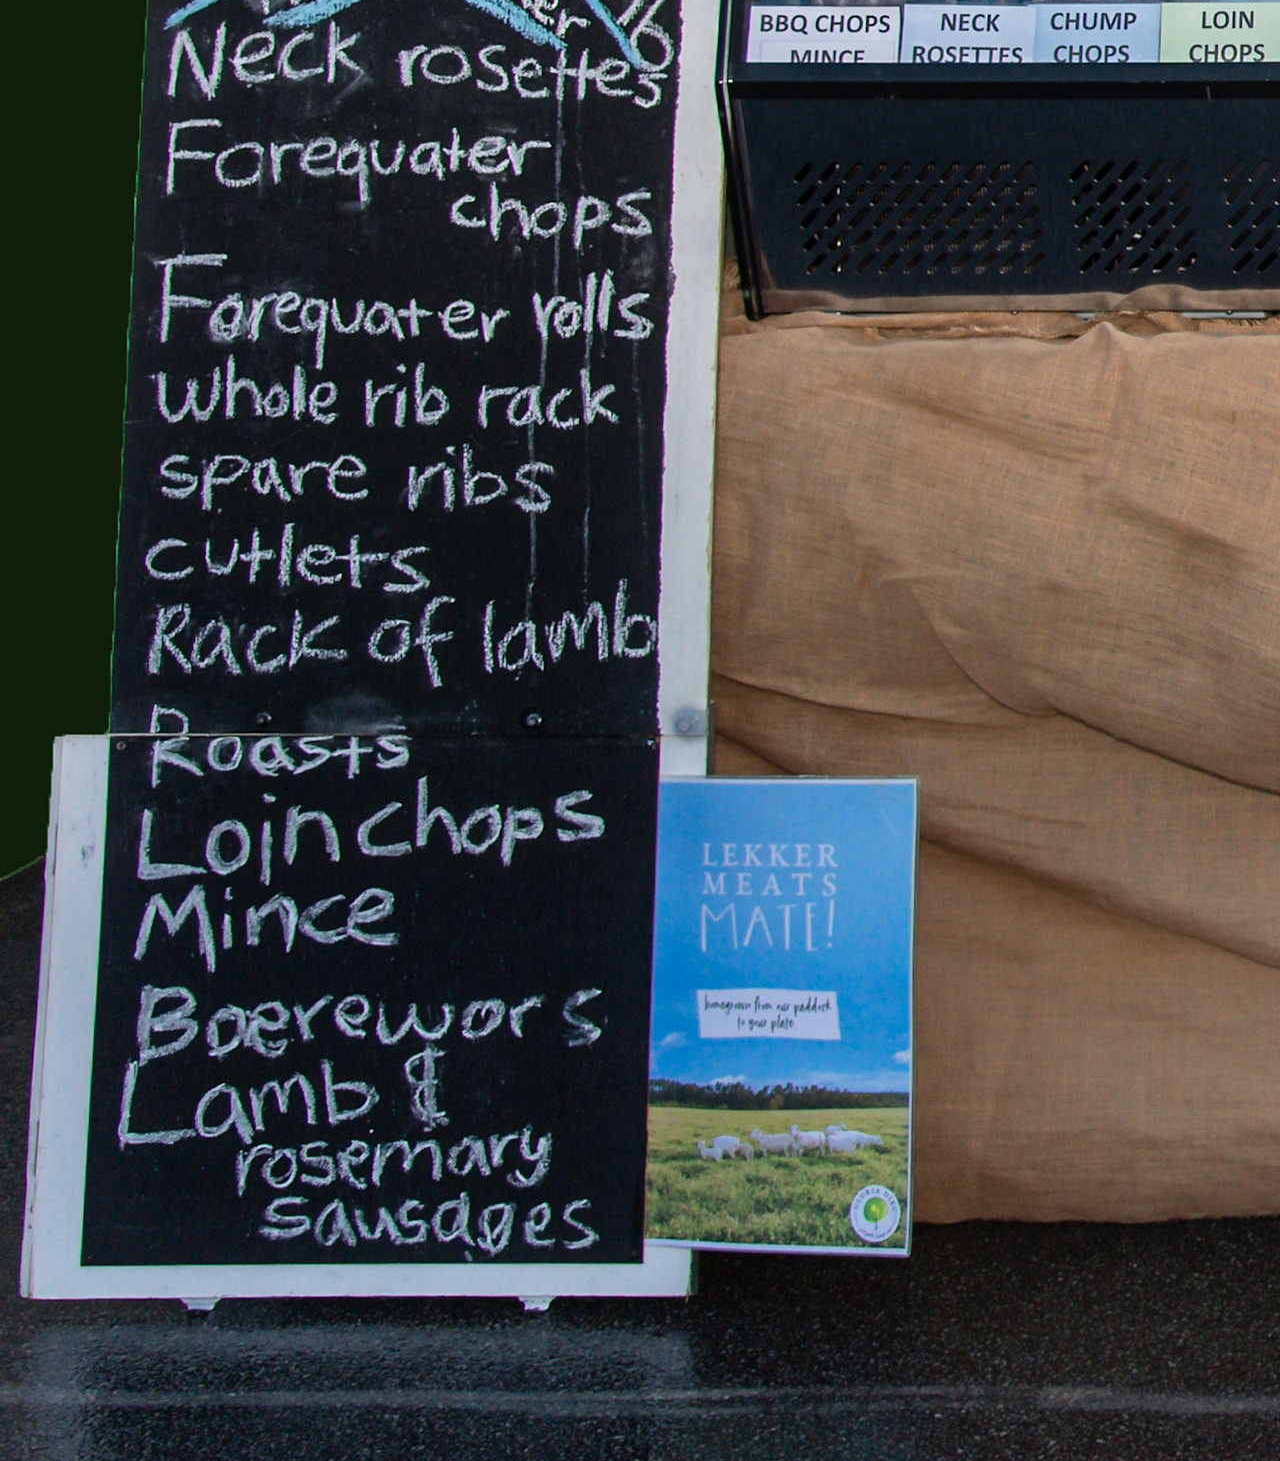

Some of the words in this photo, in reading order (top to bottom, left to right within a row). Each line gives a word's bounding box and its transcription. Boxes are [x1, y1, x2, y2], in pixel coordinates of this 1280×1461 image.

[760, 15, 808, 34] BBQ
[815, 15, 891, 33] CHOPS
[940, 13, 1000, 32] NECK
[1050, 12, 1137, 30] CHUMP
[1189, 44, 1266, 62] CHOPS
[1201, 11, 1255, 29] LOIN
[165, 20, 364, 100] Neck
[398, 44, 670, 108] rosettes
[790, 49, 865, 63] MINCE
[913, 46, 1023, 63] ROSETTES
[1053, 45, 1131, 63] CHOPS
[165, 120, 551, 209] Forequater
[450, 182, 653, 249] chops
[155, 253, 509, 369] Forequater
[533, 270, 654, 340] rolls
[365, 362, 449, 427] rib
[478, 368, 620, 429] rack
[159, 454, 369, 511] spare
[408, 443, 555, 513] ribs
[145, 523, 431, 592] cutlets
[146, 603, 347, 675] Rack
[368, 595, 455, 688] of
[484, 578, 658, 673] lamb
[148, 703, 412, 789] Roasts
[137, 792, 340, 886] Loin
[356, 775, 606, 866] chops
[702, 843, 839, 868] LEKKER
[702, 872, 838, 896] MEATS
[134, 884, 399, 973] Mince
[701, 899, 836, 953] MATE!
[137, 984, 604, 1066] Boerewors
[704, 994, 751, 1015] homegrown
[755, 995, 773, 1012] from
[776, 1003, 790, 1012] our
[793, 996, 831, 1017] paddock
[737, 1017, 745, 1029] to
[748, 1020, 767, 1031] your
[118, 1060, 379, 1150] Lamb
[236, 1124, 553, 1196] rosemary
[258, 1191, 600, 1256] sausages
